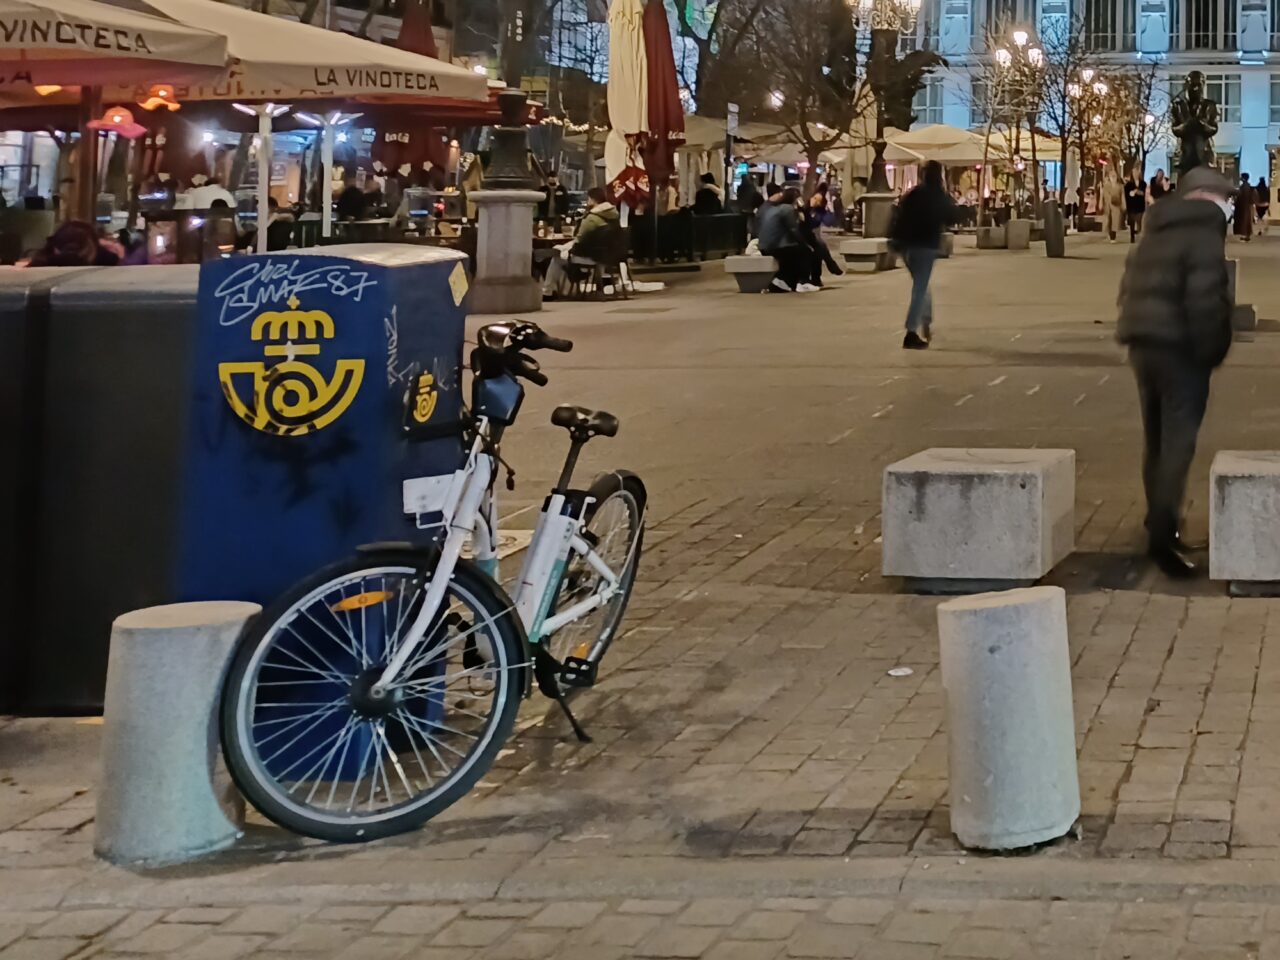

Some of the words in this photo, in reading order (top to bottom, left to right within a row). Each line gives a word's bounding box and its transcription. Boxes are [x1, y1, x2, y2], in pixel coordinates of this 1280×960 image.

[0, 19, 152, 54] VINOTECA
[314, 68, 338, 86] LA
[346, 69, 439, 91] VINOTECA
